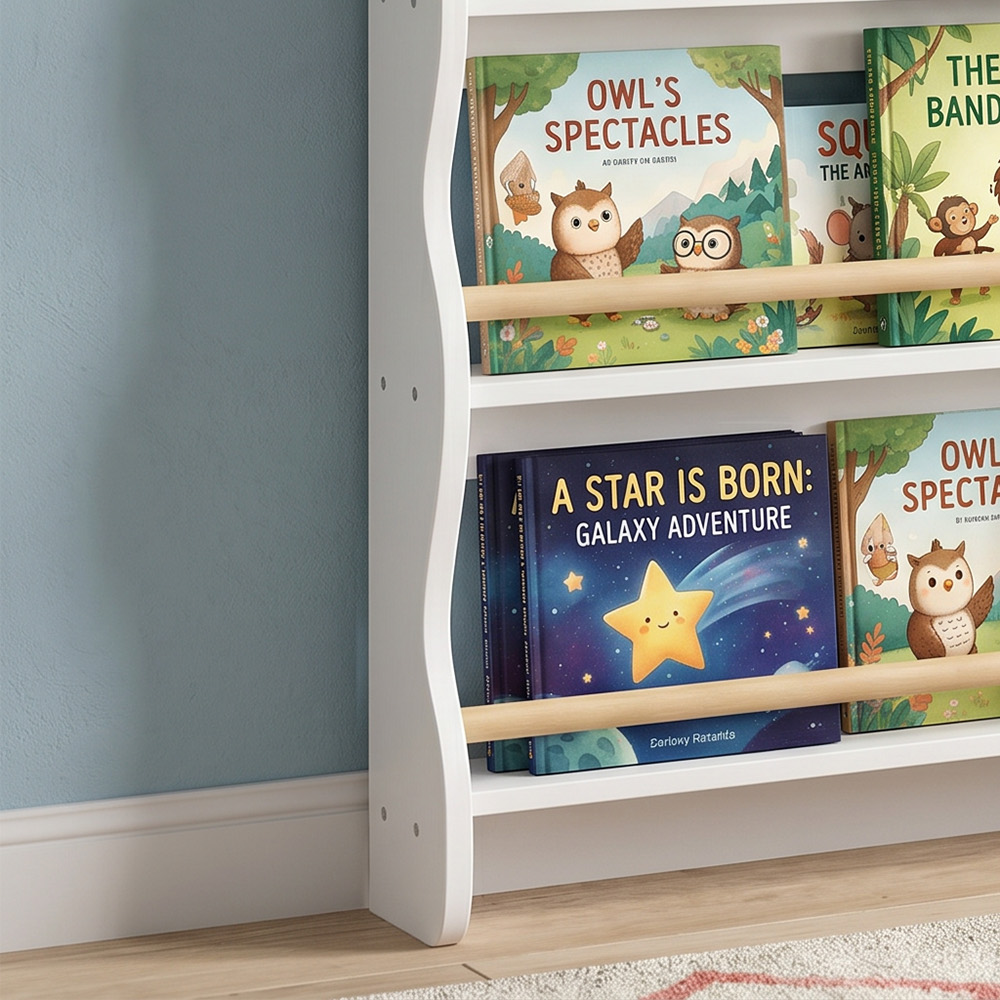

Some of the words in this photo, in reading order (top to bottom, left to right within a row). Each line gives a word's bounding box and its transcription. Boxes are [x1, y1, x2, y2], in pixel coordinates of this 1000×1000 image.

[947, 54, 1000, 87] THE
[587, 77, 681, 111] OWL'S
[545, 113, 731, 152] SPECTACLES
[820, 164, 849, 181] THE
[552, 478, 573, 515] A
[586, 471, 664, 511] STAR
[678, 467, 706, 504] IS
[719, 460, 813, 500] BORN:
[576, 517, 659, 546] GALAXY
[668, 505, 792, 539] ADVENTURE
